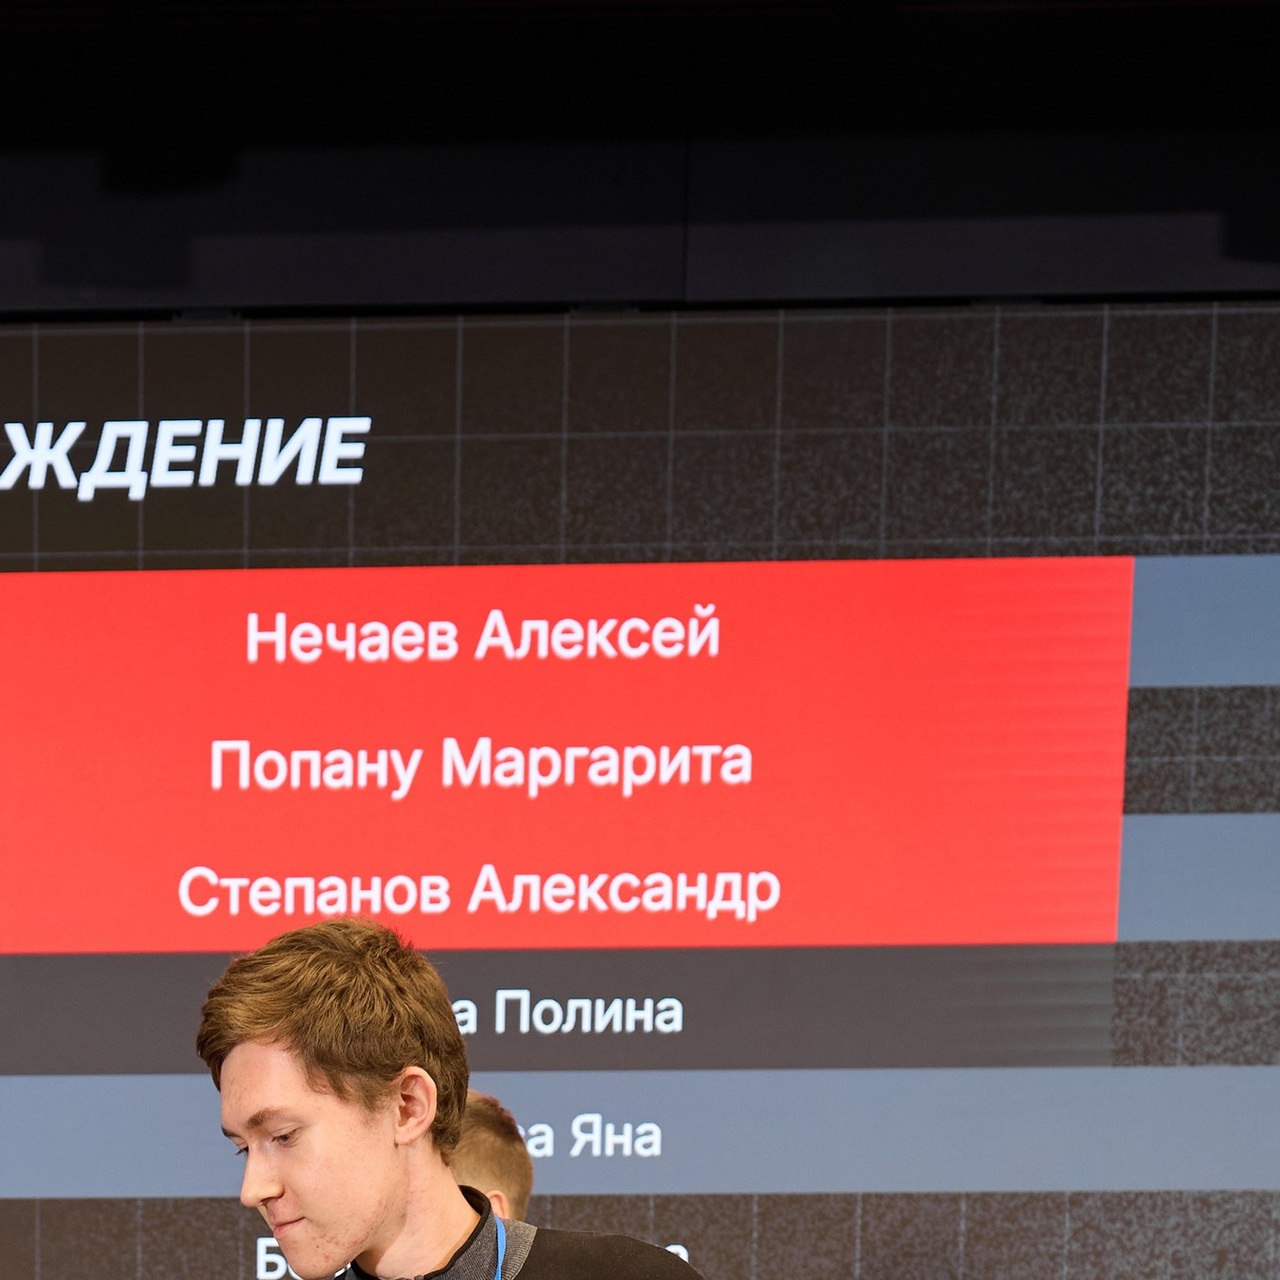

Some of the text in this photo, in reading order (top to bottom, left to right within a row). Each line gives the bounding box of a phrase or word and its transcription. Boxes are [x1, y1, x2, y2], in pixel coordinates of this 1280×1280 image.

[247, 603, 720, 663] Нечаев Алексей
[211, 737, 752, 800] Попану Маргарита
[178, 863, 781, 923] Степанов Александр
[495, 989, 683, 1035] Полина
[570, 1112, 662, 1157] Яна
